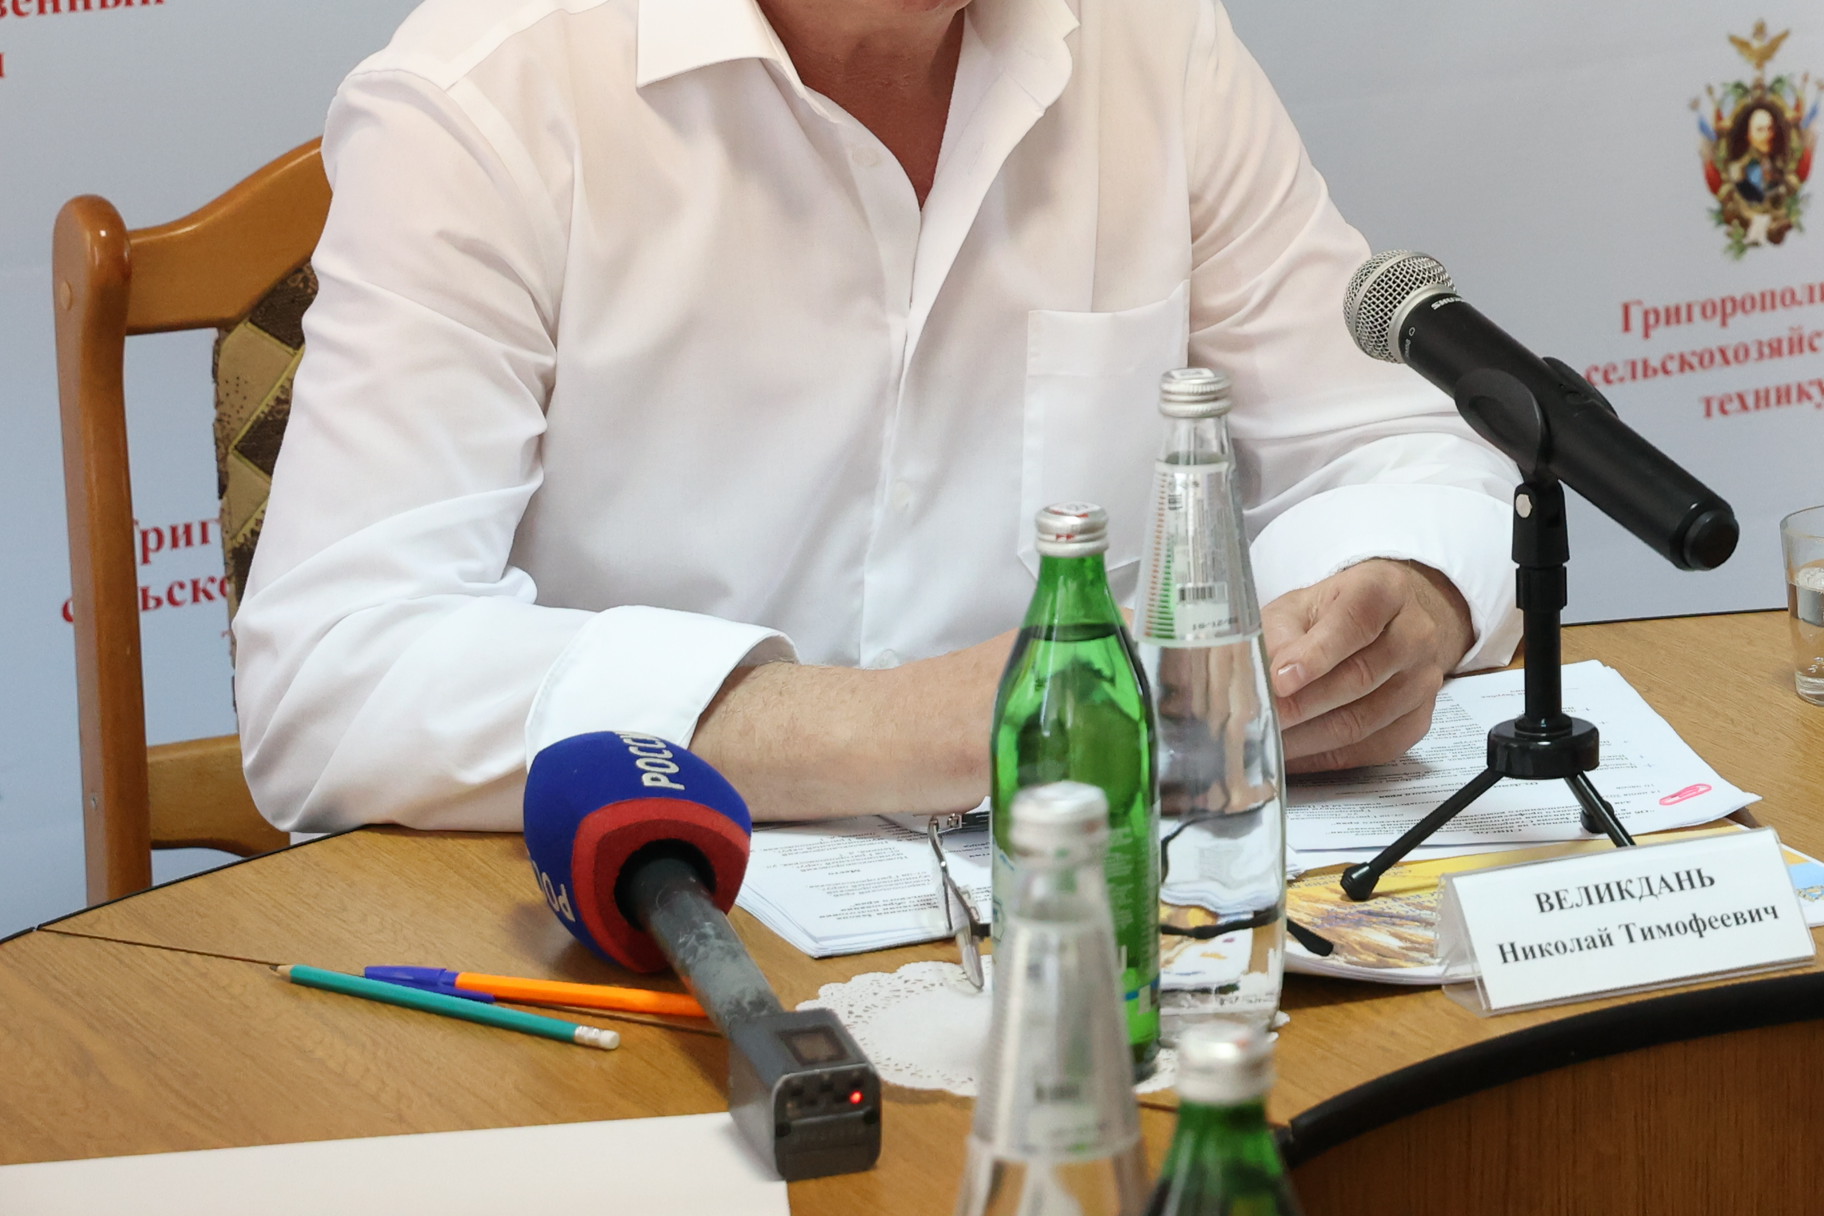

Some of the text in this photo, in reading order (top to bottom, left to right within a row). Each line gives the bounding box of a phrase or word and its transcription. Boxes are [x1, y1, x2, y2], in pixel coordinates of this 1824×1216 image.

[1534, 867, 1716, 914] ВЕЛИКДАНЬ
[1497, 904, 1780, 965] Николай Тимофеевич
